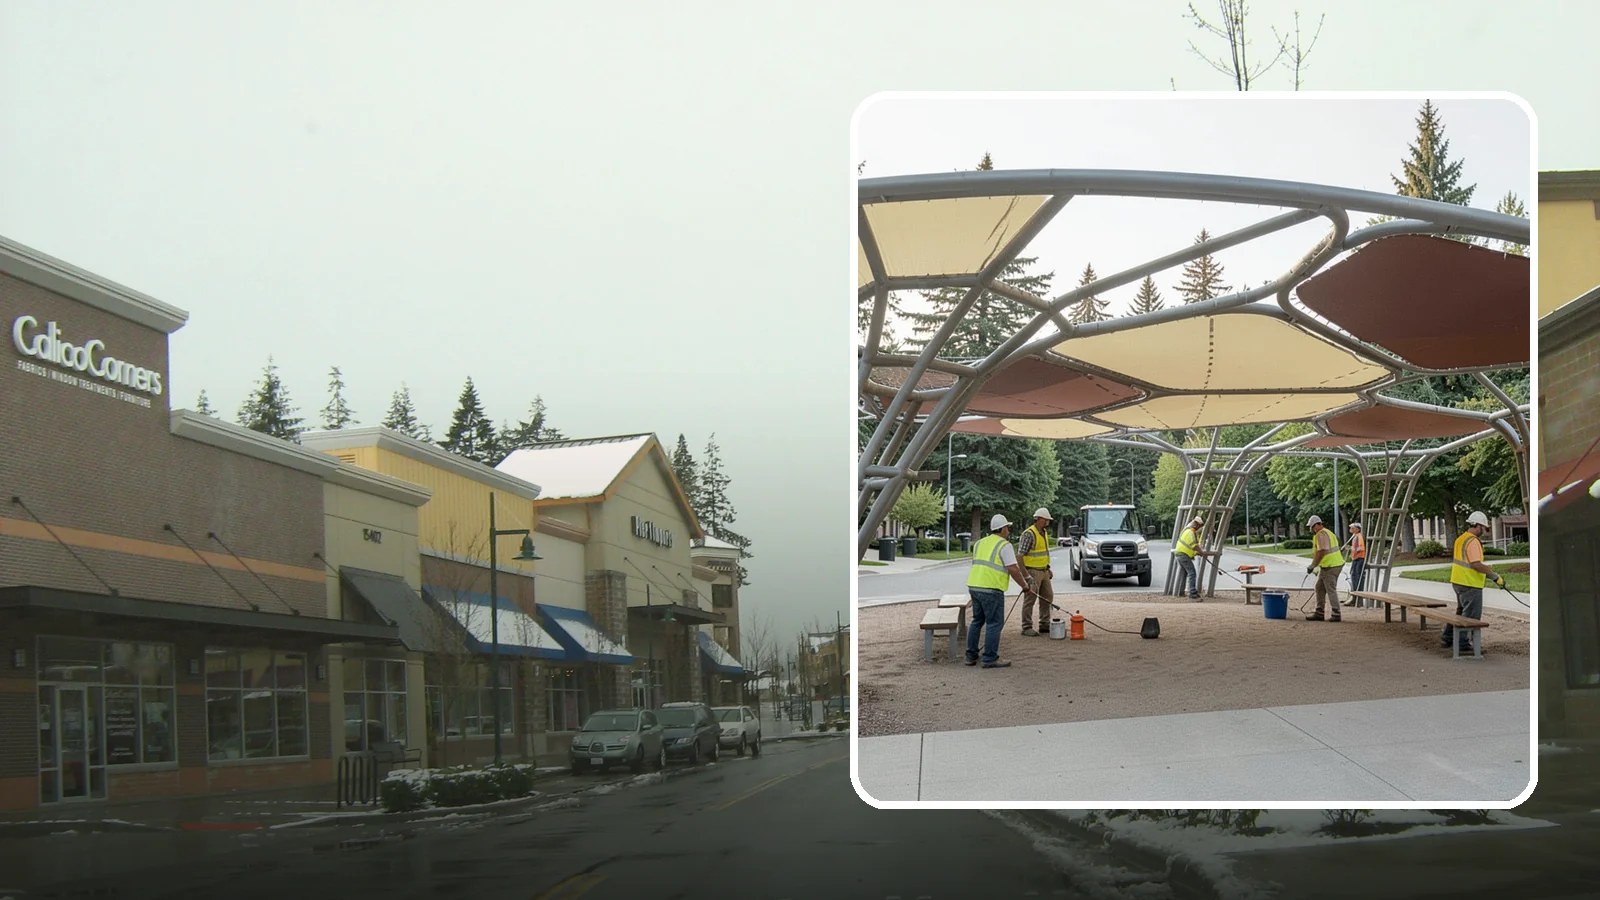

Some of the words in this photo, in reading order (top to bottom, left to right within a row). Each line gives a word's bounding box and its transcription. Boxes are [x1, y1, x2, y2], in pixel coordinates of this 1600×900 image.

[17, 360, 47, 377] FABRICS
[51, 371, 78, 386] WINDOW
[79, 379, 117, 398] TREATMENTS
[120, 391, 151, 409] FURNITURE
